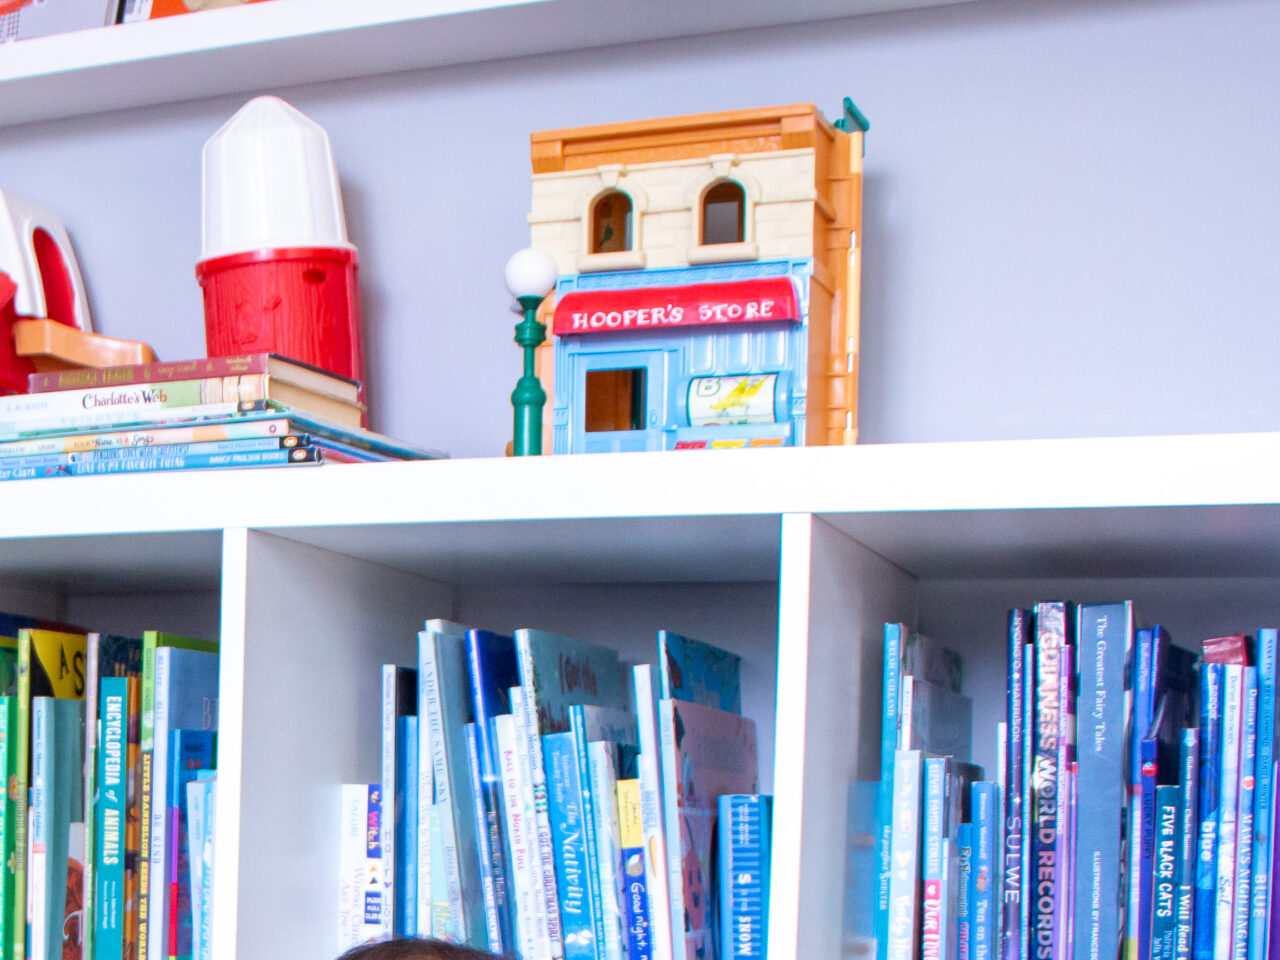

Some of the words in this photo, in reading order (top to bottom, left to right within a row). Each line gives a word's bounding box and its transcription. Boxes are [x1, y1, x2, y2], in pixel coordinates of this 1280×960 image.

[572, 304, 683, 329] HOOPER'S
[698, 300, 774, 321] STORE
[82, 391, 140, 410] Charlotte's
[141, 388, 168, 405] Web
[12, 466, 36, 479] Clark
[208, 456, 233, 465] NANCY
[262, 451, 286, 462] BOOKS
[1096, 615, 1109, 639] The
[1095, 640, 1107, 687] Greatest
[424, 660, 438, 704] UNDER
[1039, 631, 1060, 751] GUINNESS
[1012, 683, 1022, 743] HARRISON
[1091, 690, 1107, 719] Fairy
[104, 695, 123, 786] ENCYCLOPEDIA
[1094, 721, 1106, 752] Tales
[142, 753, 153, 793] LITTLE
[106, 789, 118, 803] of
[1037, 755, 1058, 844] WORLD
[140, 795, 152, 859] DANDELION
[152, 814, 162, 829] BE
[366, 810, 380, 850] Witch
[566, 803, 579, 827] The
[1161, 805, 1176, 836] FIVE
[102, 807, 121, 866] ANIMALS
[152, 836, 162, 865] KIND
[538, 831, 549, 849] GOT
[1200, 821, 1217, 862] blue
[1239, 813, 1253, 863] MAMA'S
[540, 851, 551, 866] THE
[561, 823, 585, 914] Nativity
[1004, 816, 1022, 904] SULWE
[1159, 840, 1175, 879] BLACK
[140, 860, 150, 895] SEEDS
[482, 876, 493, 905] SOME
[492, 877, 504, 906] Harlem
[542, 868, 558, 915] CHRISTMAS
[738, 872, 753, 885] S
[1092, 851, 1101, 908] ILLUSTRATIONS
[139, 898, 149, 920] THE
[631, 882, 645, 913] Good
[1036, 850, 1056, 960] RECORDS
[1156, 882, 1174, 918] CATS
[1178, 894, 1191, 920] Will
[1253, 873, 1268, 919] BLUE
[484, 907, 497, 942] SNOW
[547, 917, 560, 943] SPIRIT
[922, 898, 942, 931] OUR
[631, 915, 649, 951] night,
[738, 915, 753, 956] SNOW
[1177, 924, 1190, 954] Read
